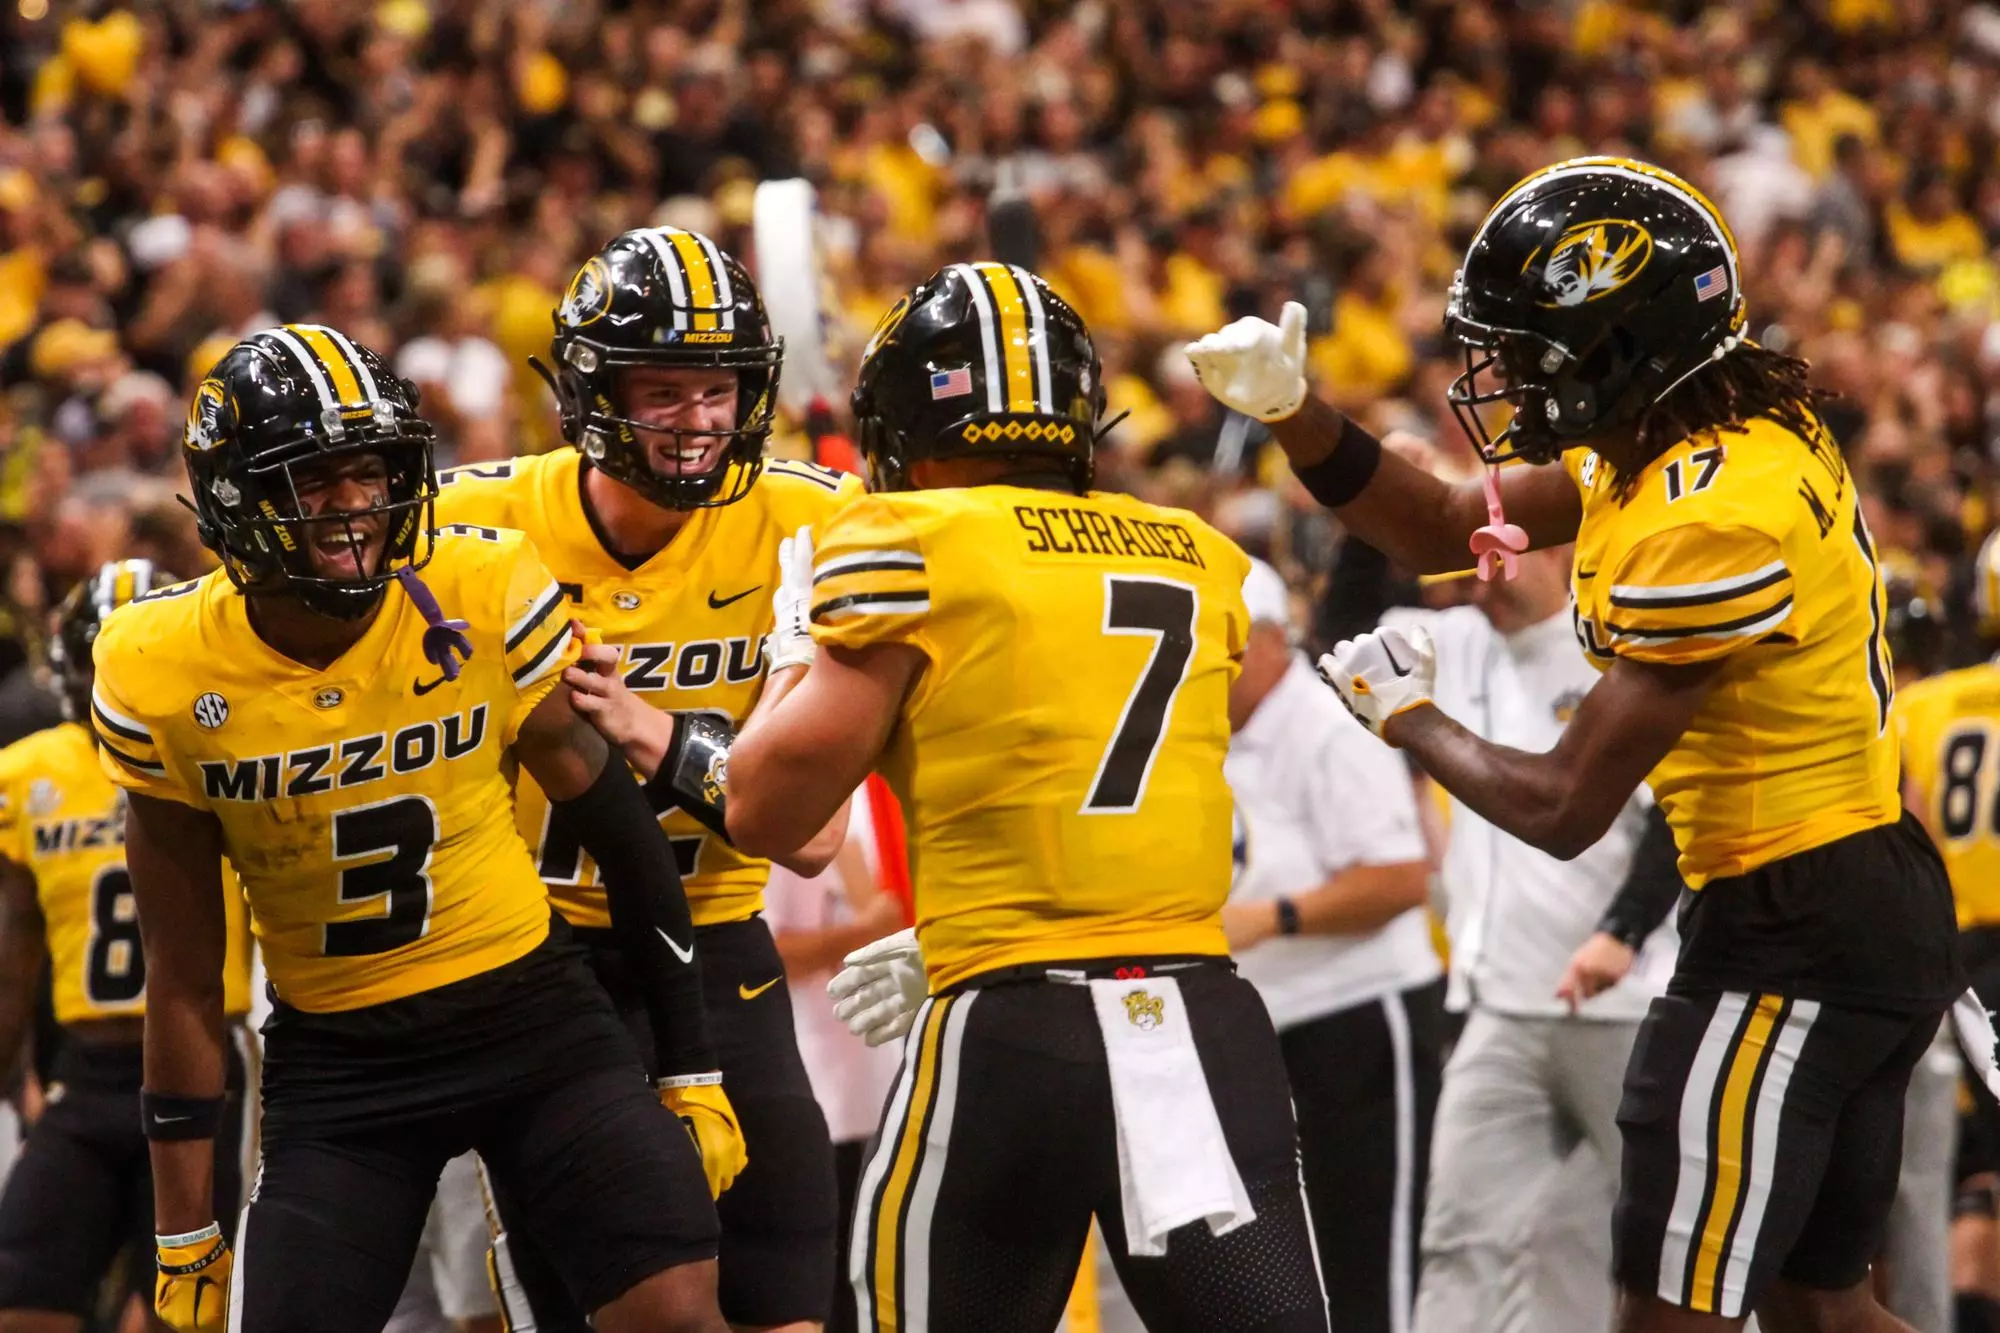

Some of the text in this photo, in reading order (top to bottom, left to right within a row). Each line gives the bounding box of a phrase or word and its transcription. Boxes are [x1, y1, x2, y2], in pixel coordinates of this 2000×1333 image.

[684, 333, 734, 344] MIZZOU
[1664, 445, 1727, 504] 17
[1014, 506, 1206, 570] SCHRADER
[194, 692, 228, 728] SEC
[1078, 572, 1198, 815] 7
[199, 701, 489, 801] MIZZOU
[322, 793, 441, 957] 3
